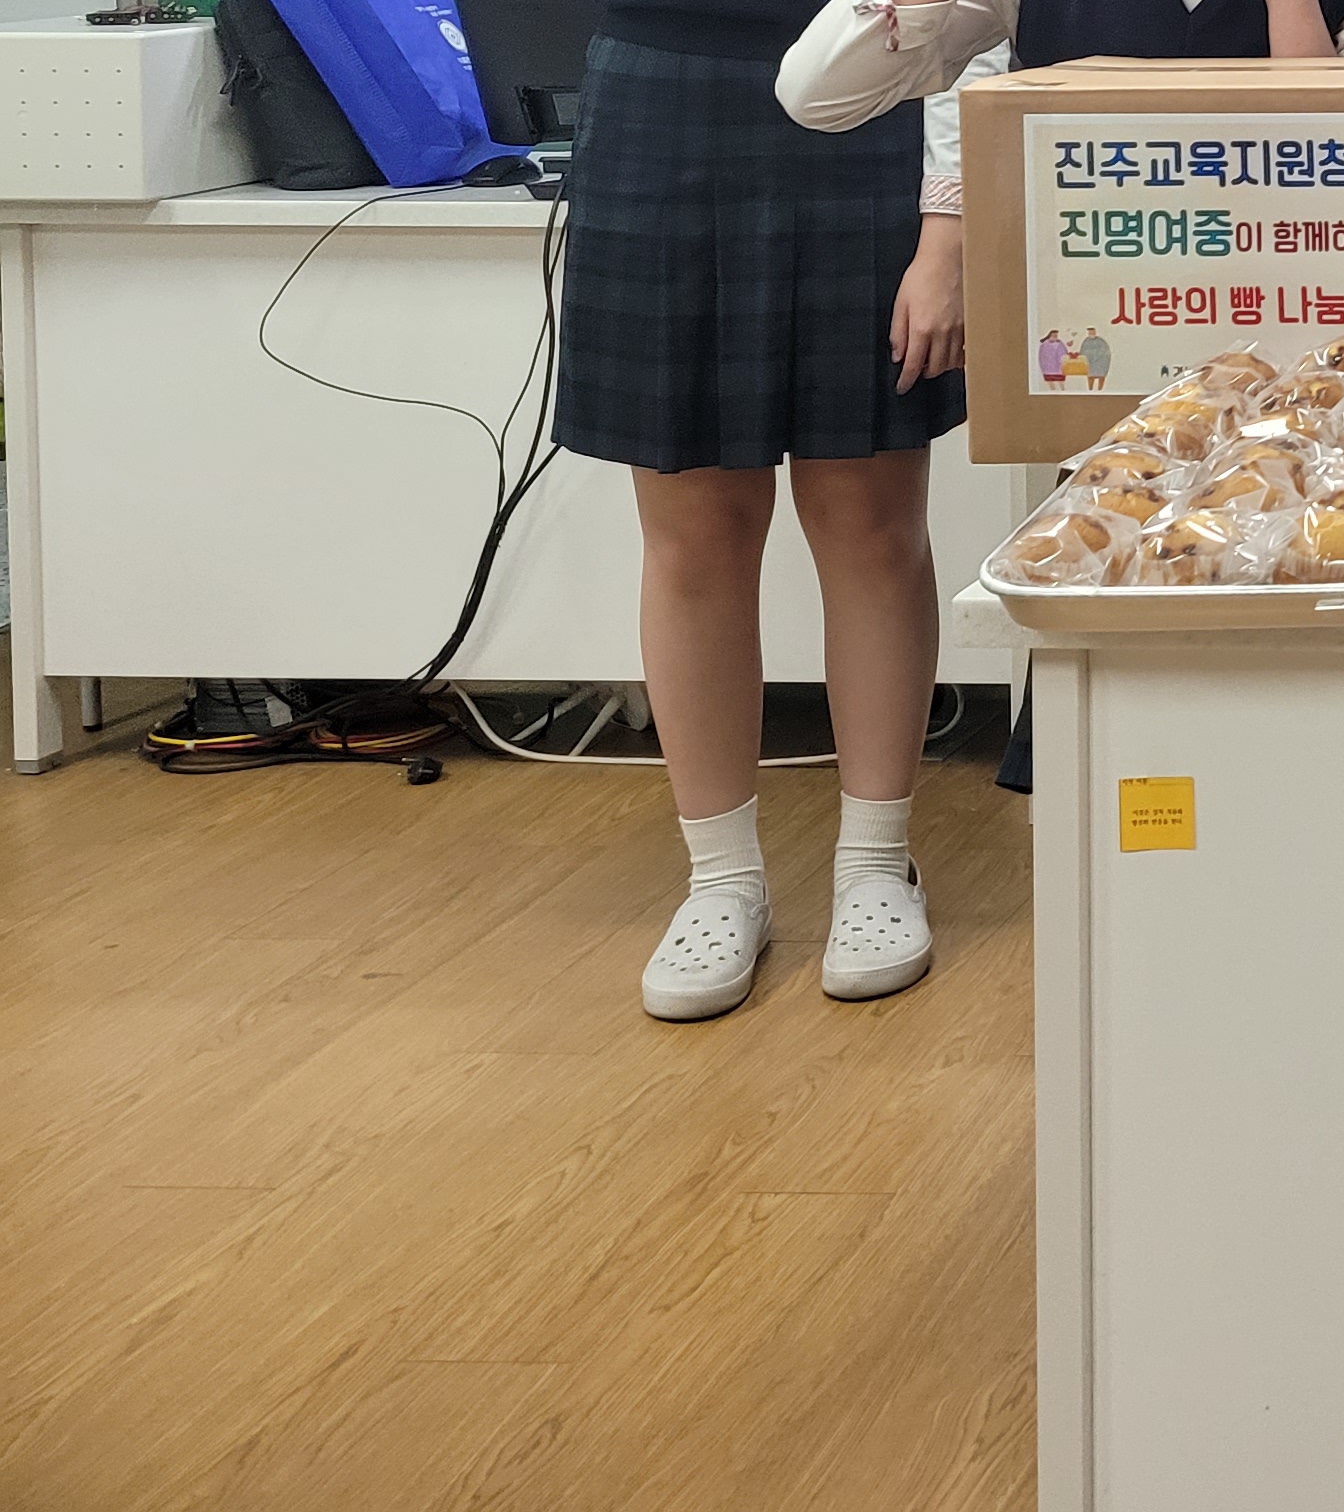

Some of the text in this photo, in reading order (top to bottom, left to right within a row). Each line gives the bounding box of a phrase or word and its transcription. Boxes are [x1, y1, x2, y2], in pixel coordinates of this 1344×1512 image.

[1059, 209, 1263, 258] 진명여중이
[1111, 285, 1217, 326] 사랑의
[1229, 286, 1265, 326] 빵
